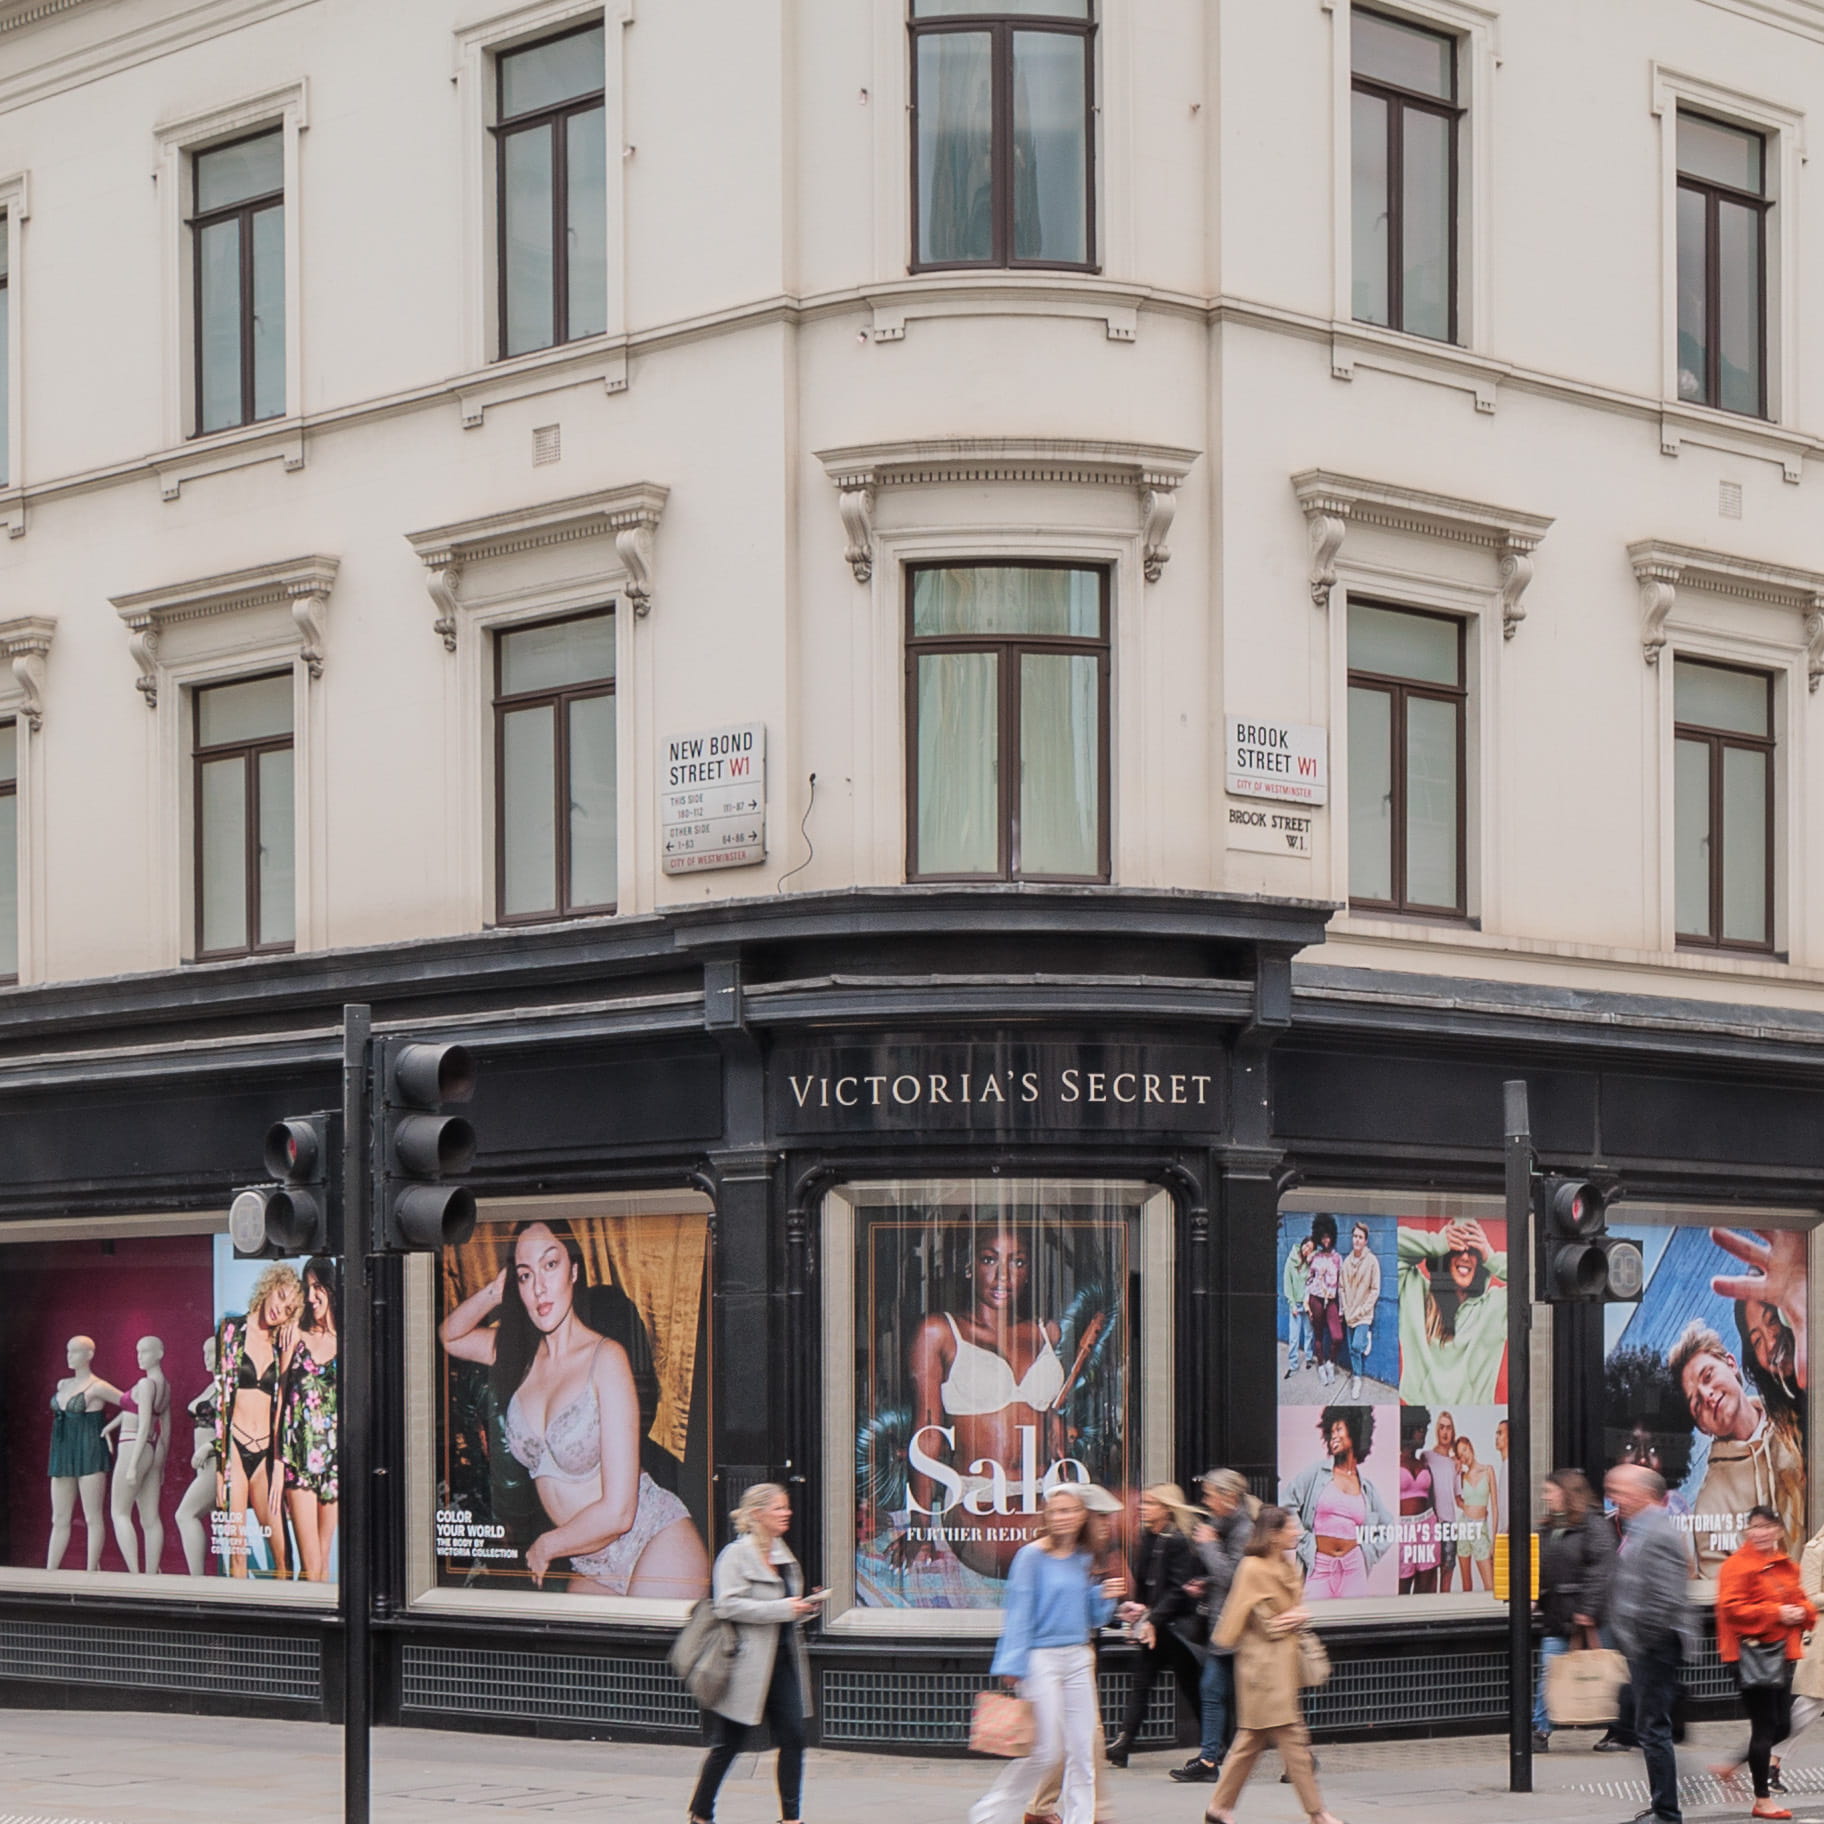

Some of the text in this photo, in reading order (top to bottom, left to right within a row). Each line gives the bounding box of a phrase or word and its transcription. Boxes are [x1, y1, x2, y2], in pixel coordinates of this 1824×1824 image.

[1237, 723, 1289, 749] BROOK
[669, 731, 753, 762] NEW BOND
[669, 755, 750, 786] STREET W1
[1237, 747, 1317, 778] STREET W1
[1237, 778, 1312, 797] CITY OF WESTMINSTER
[670, 792, 704, 806] THIS SIDE
[1229, 808, 1311, 833] BROOK STREET
[670, 823, 710, 838] OTHER SIDE
[670, 850, 747, 869] CITY OF WESTMINSTER
[788, 1069, 1212, 1107] VICTORIA'S SECRET
[211, 1510, 243, 1524] COLOR
[436, 1509, 473, 1523] COLOR
[1669, 1512, 1733, 1532] VICTORIA'S
[211, 1523, 237, 1537] YOUR
[436, 1524, 506, 1538] YOUR WORLD
[906, 1527, 1042, 1542] FURTHER REDUC
[1355, 1521, 1485, 1545] VICTORIA'S SECRET
[436, 1537, 485, 1548] THE BODY BY
[1709, 1532, 1738, 1552] PINK
[436, 1547, 519, 1559] VICTORIA COLLECTION
[1403, 1542, 1437, 1564] PINK
